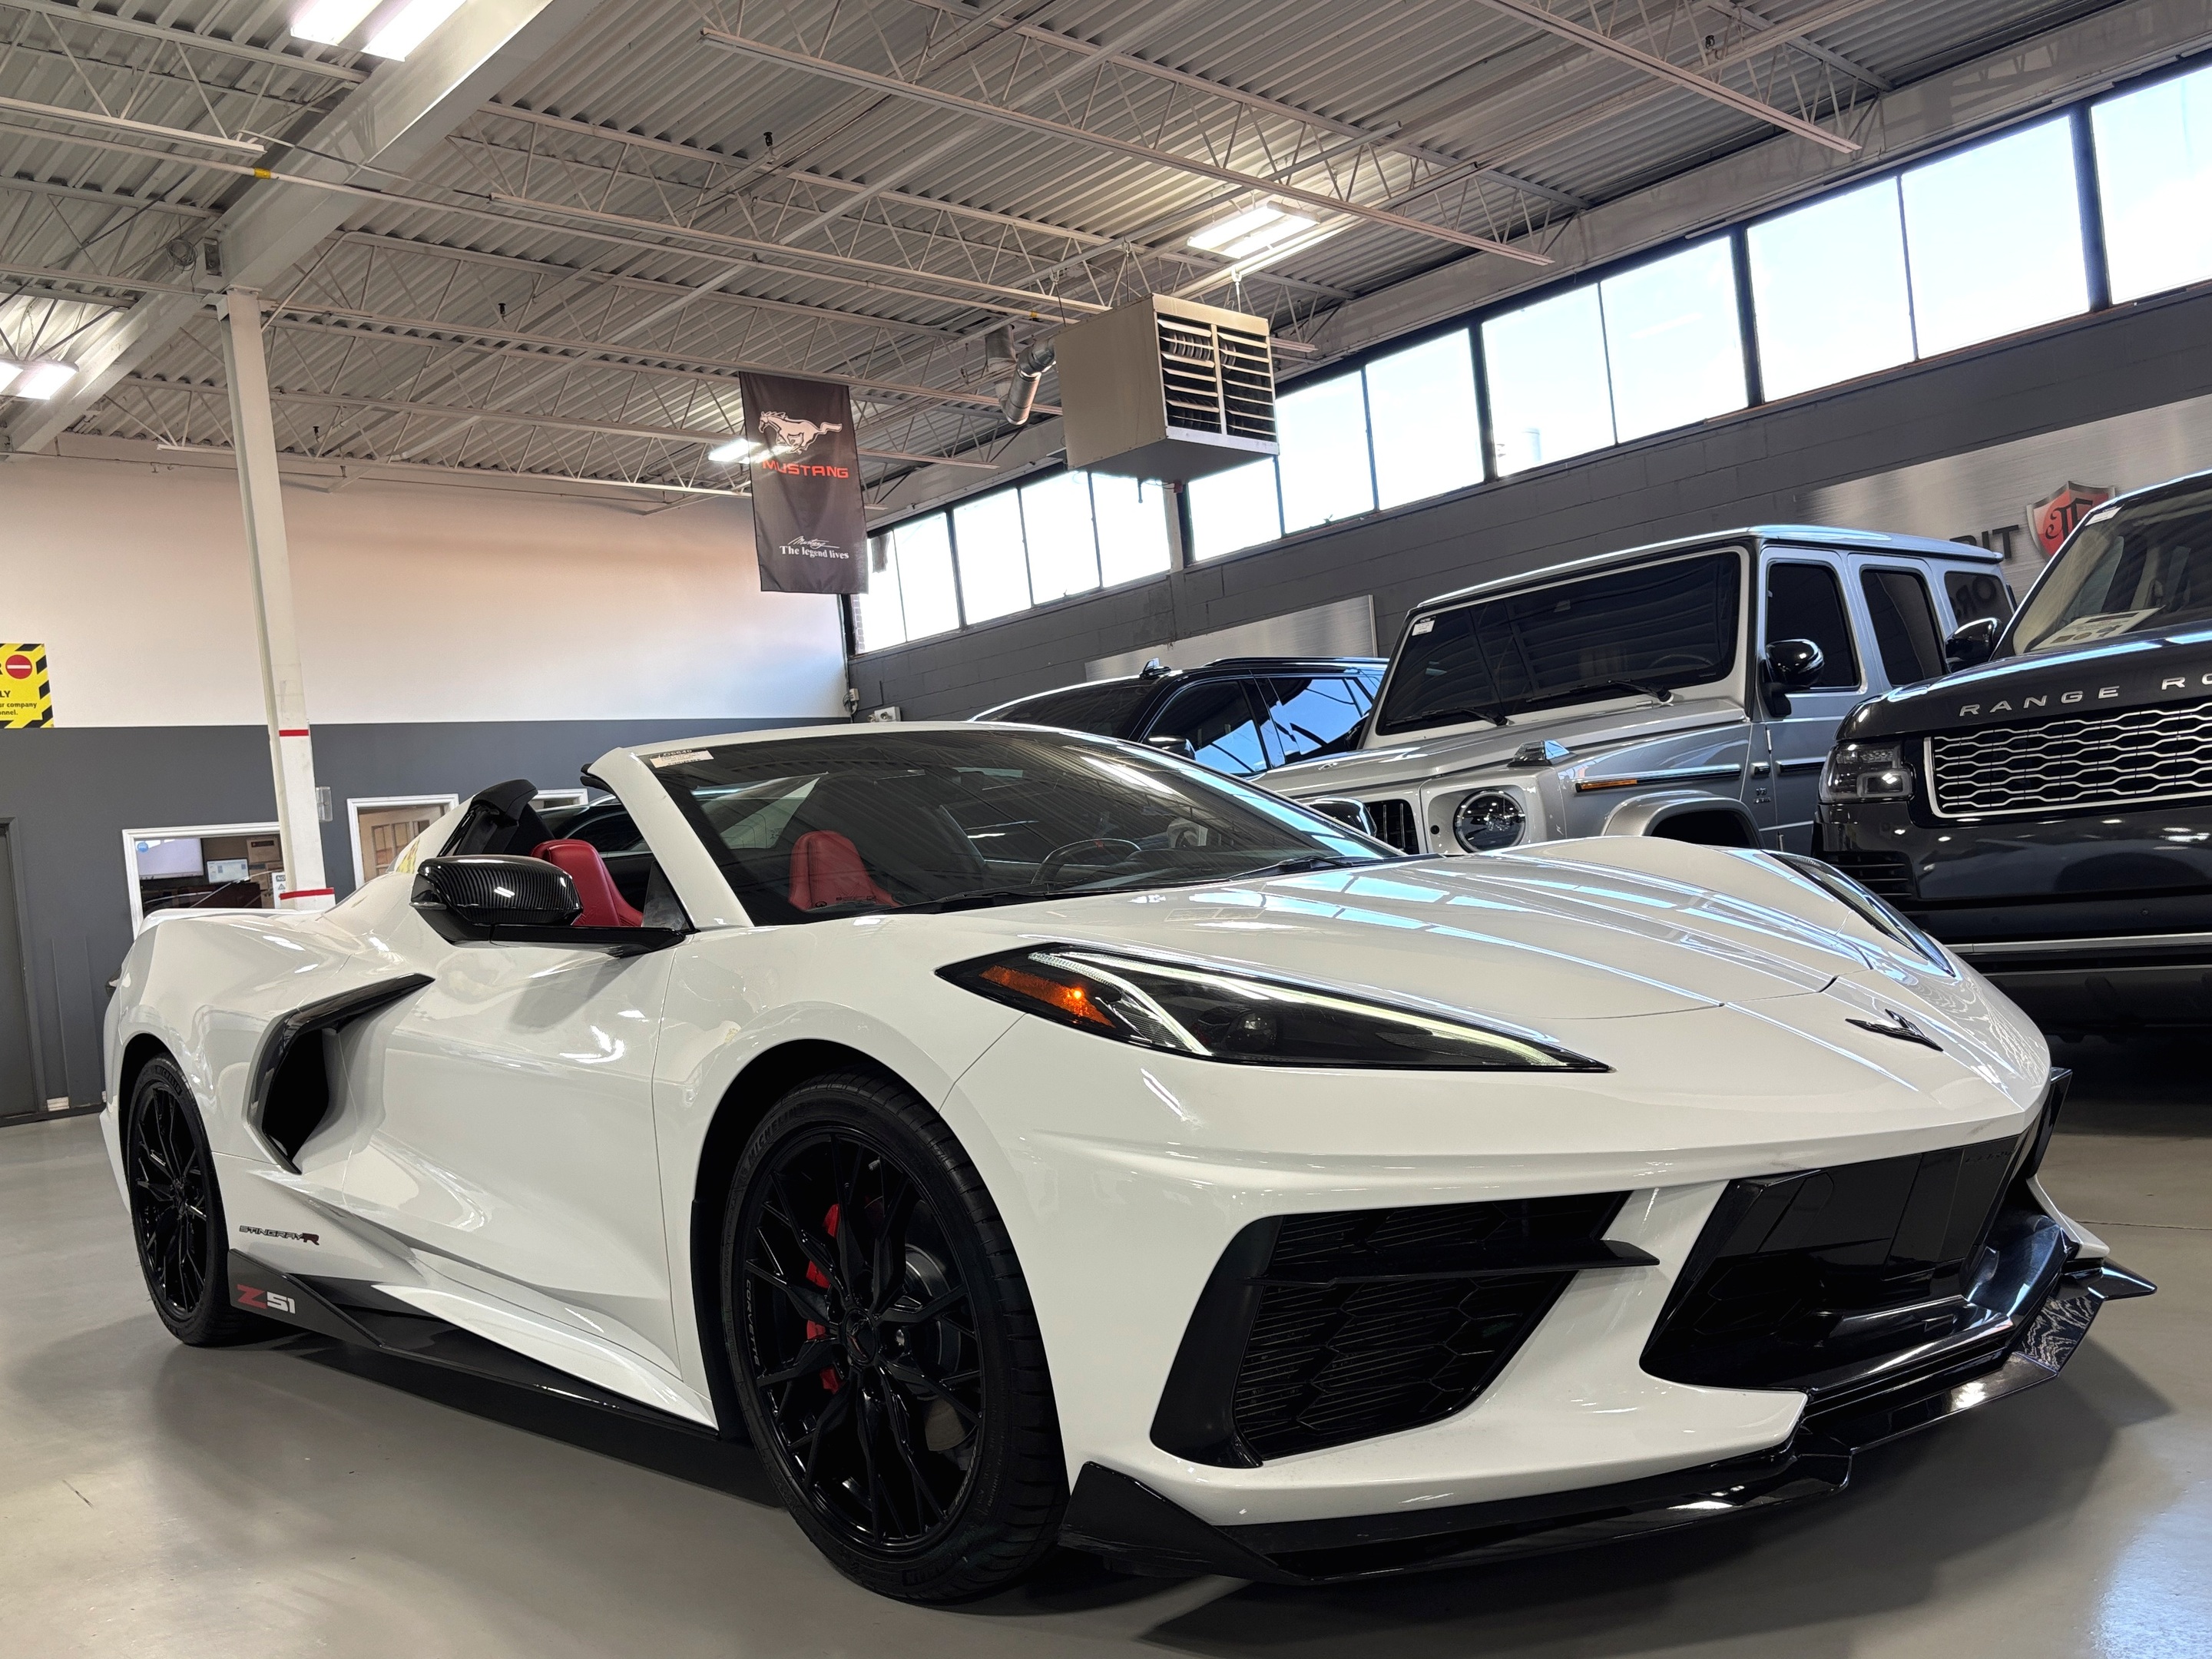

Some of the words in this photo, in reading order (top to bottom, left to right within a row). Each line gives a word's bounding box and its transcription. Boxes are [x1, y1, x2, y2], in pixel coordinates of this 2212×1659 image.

[763, 459, 849, 478] MUSTANG
[779, 545, 800, 555] The
[801, 546, 828, 558] legend
[829, 549, 849, 560] lives
[1959, 685, 2120, 717] RANGE
[237, 1283, 296, 1314] Z51
[746, 1278, 760, 1366] CORVETTE
